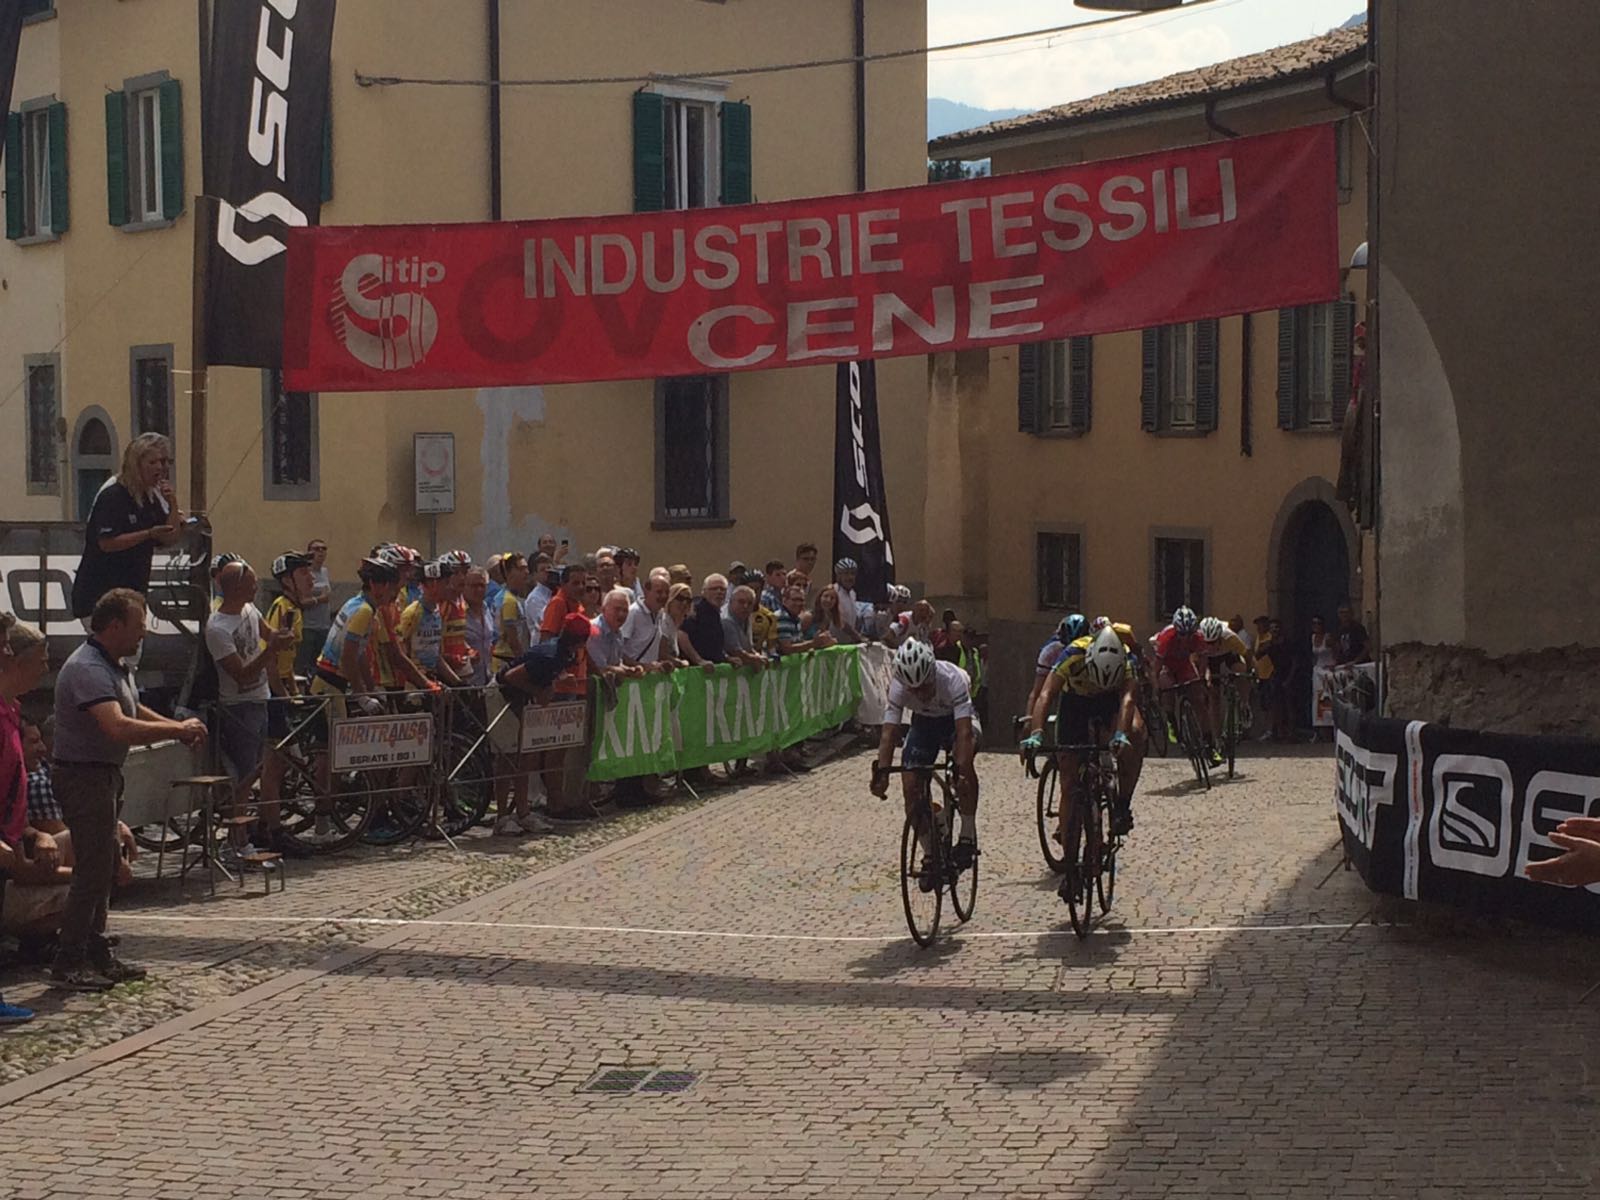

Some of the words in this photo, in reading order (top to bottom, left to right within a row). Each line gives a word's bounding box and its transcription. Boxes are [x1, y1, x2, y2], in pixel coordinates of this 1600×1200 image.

[523, 208, 903, 299] INDUSTRIE
[941, 158, 1238, 263] TESSILI
[330, 253, 446, 371] Sitip
[687, 275, 1045, 369] CENE
